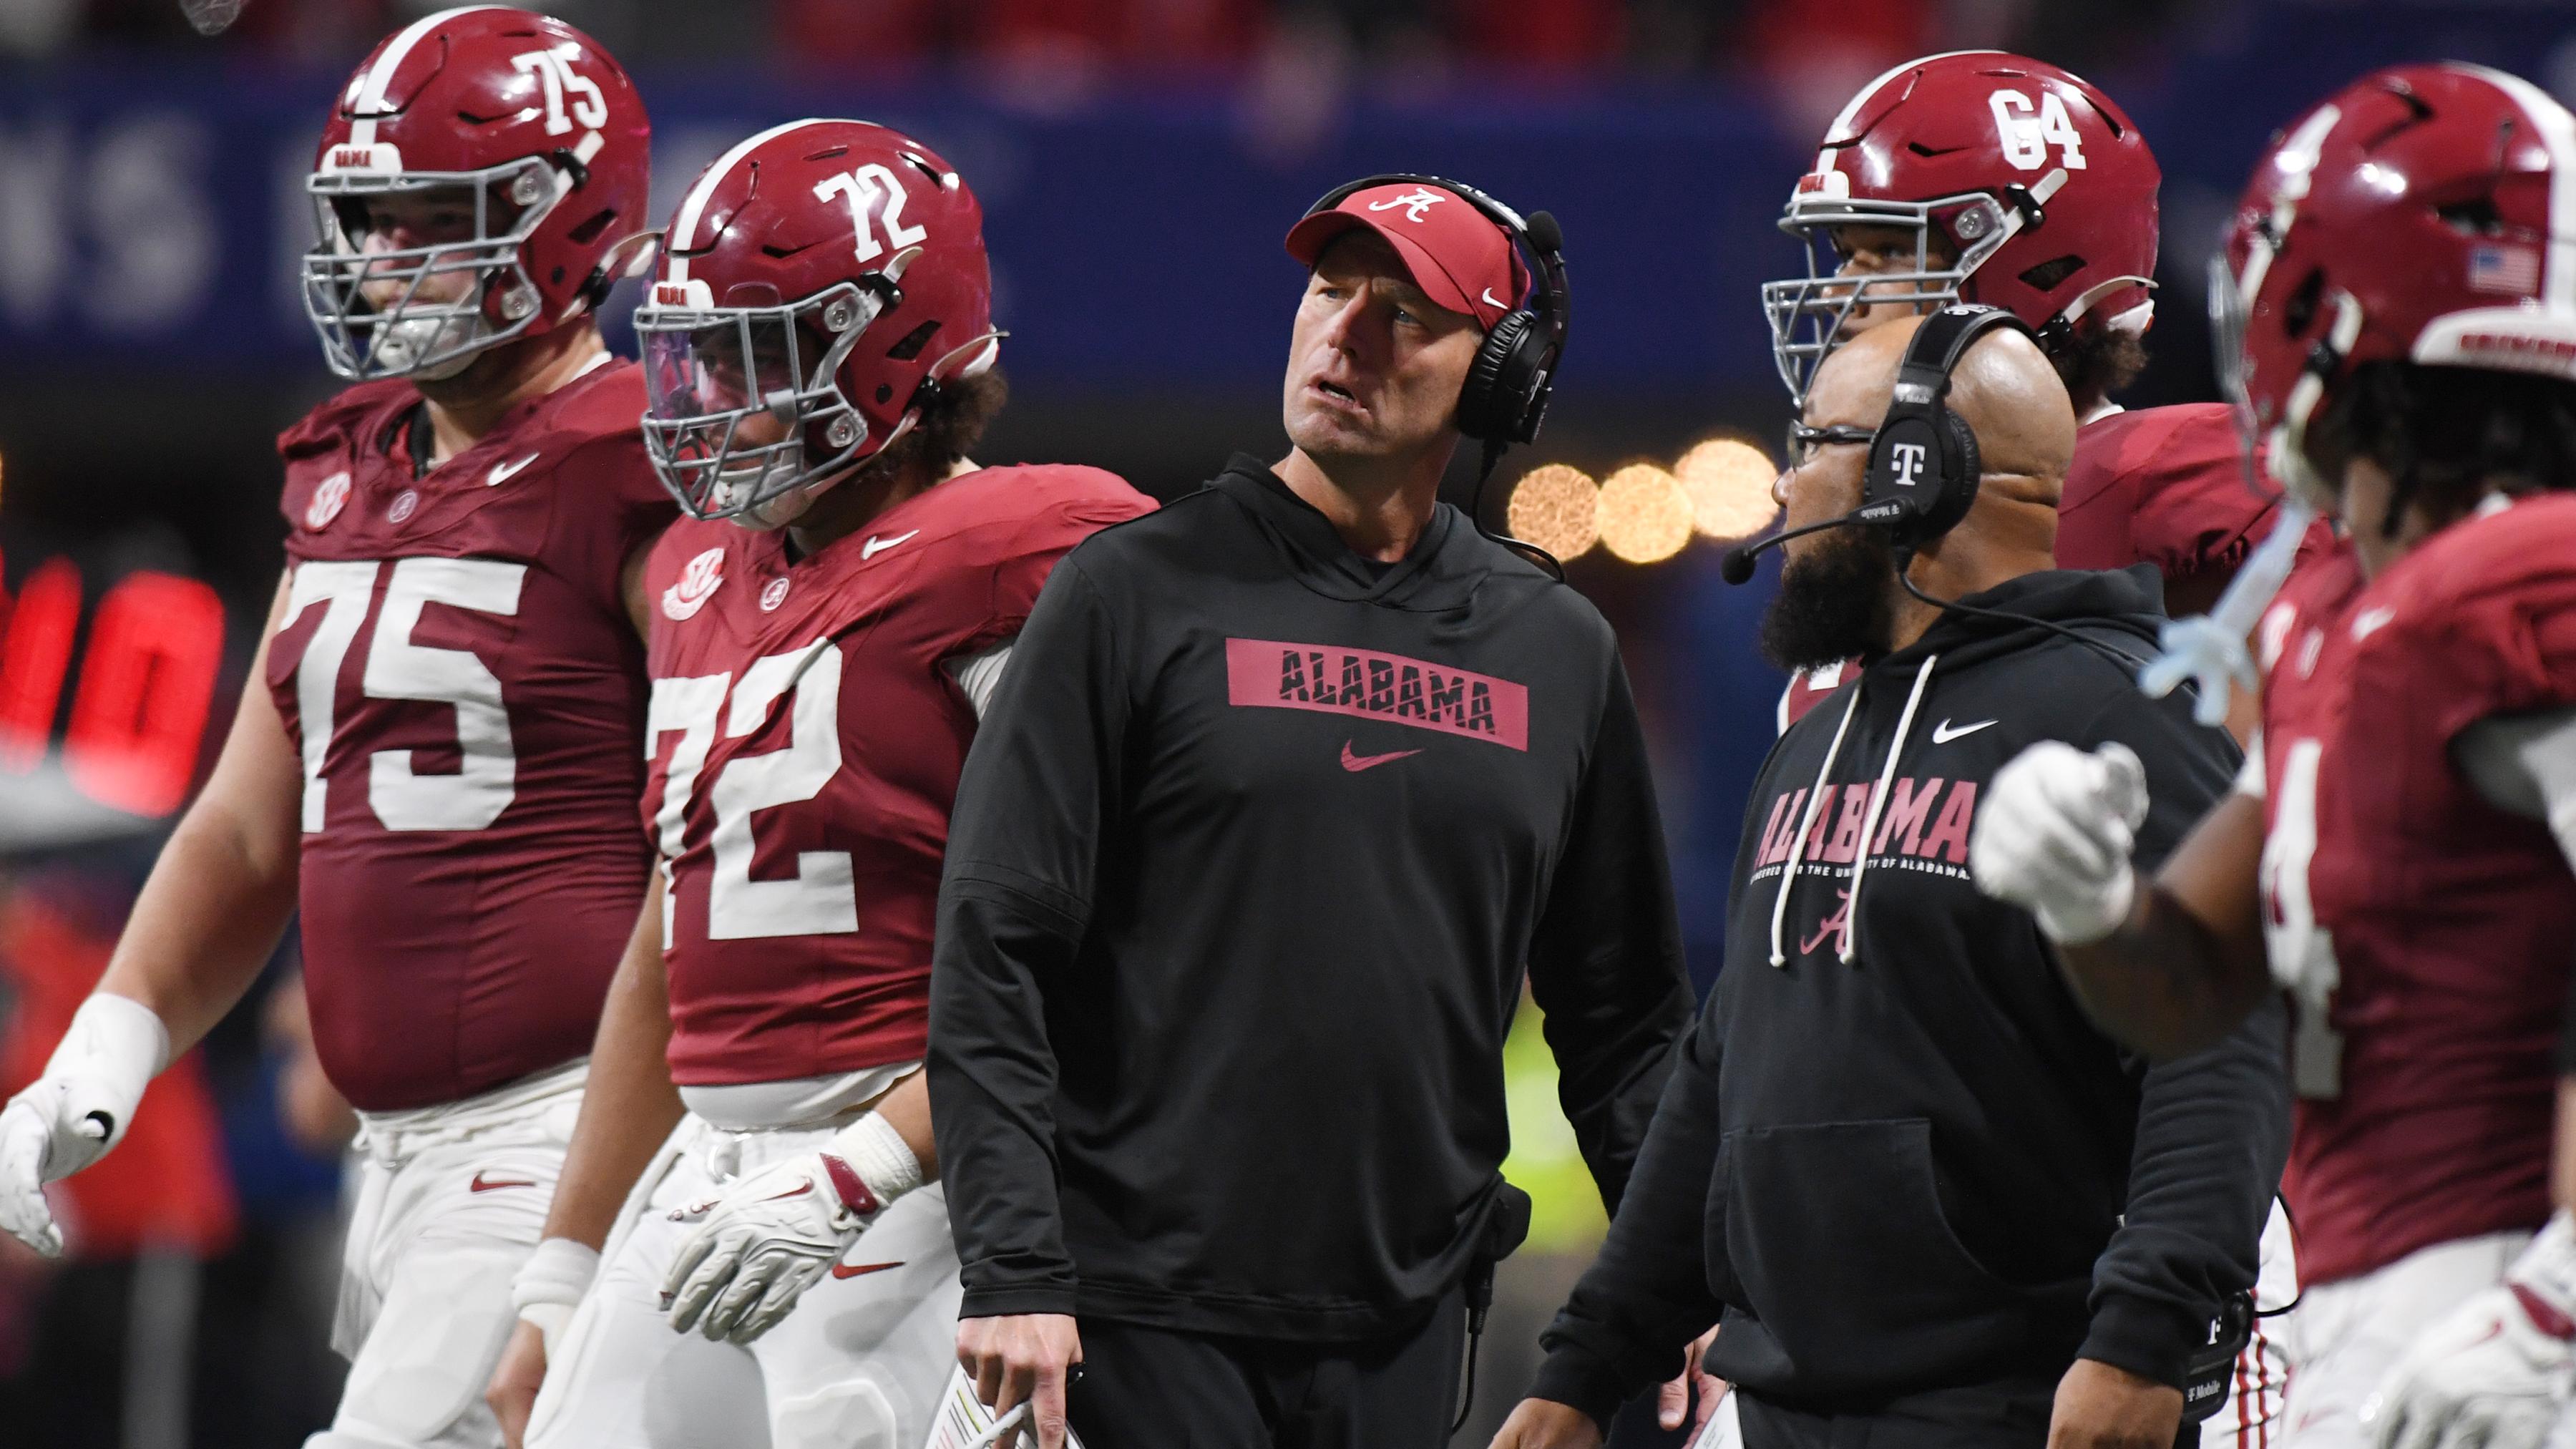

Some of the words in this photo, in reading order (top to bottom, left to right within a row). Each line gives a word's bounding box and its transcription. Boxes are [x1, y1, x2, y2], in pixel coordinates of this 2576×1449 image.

[512, 48, 609, 136] 75
[1988, 89, 2087, 171] 64
[812, 162, 928, 263] 72
[1368, 187, 1446, 223] A
[1890, 442, 1926, 486] T
[280, 557, 528, 834] 75
[1279, 650, 1496, 736] ALABAMA
[644, 635, 859, 951] 72
[1754, 776, 1978, 870] ALABMA
[1807, 864, 1830, 876] THE
[1881, 858, 1897, 869] OF
